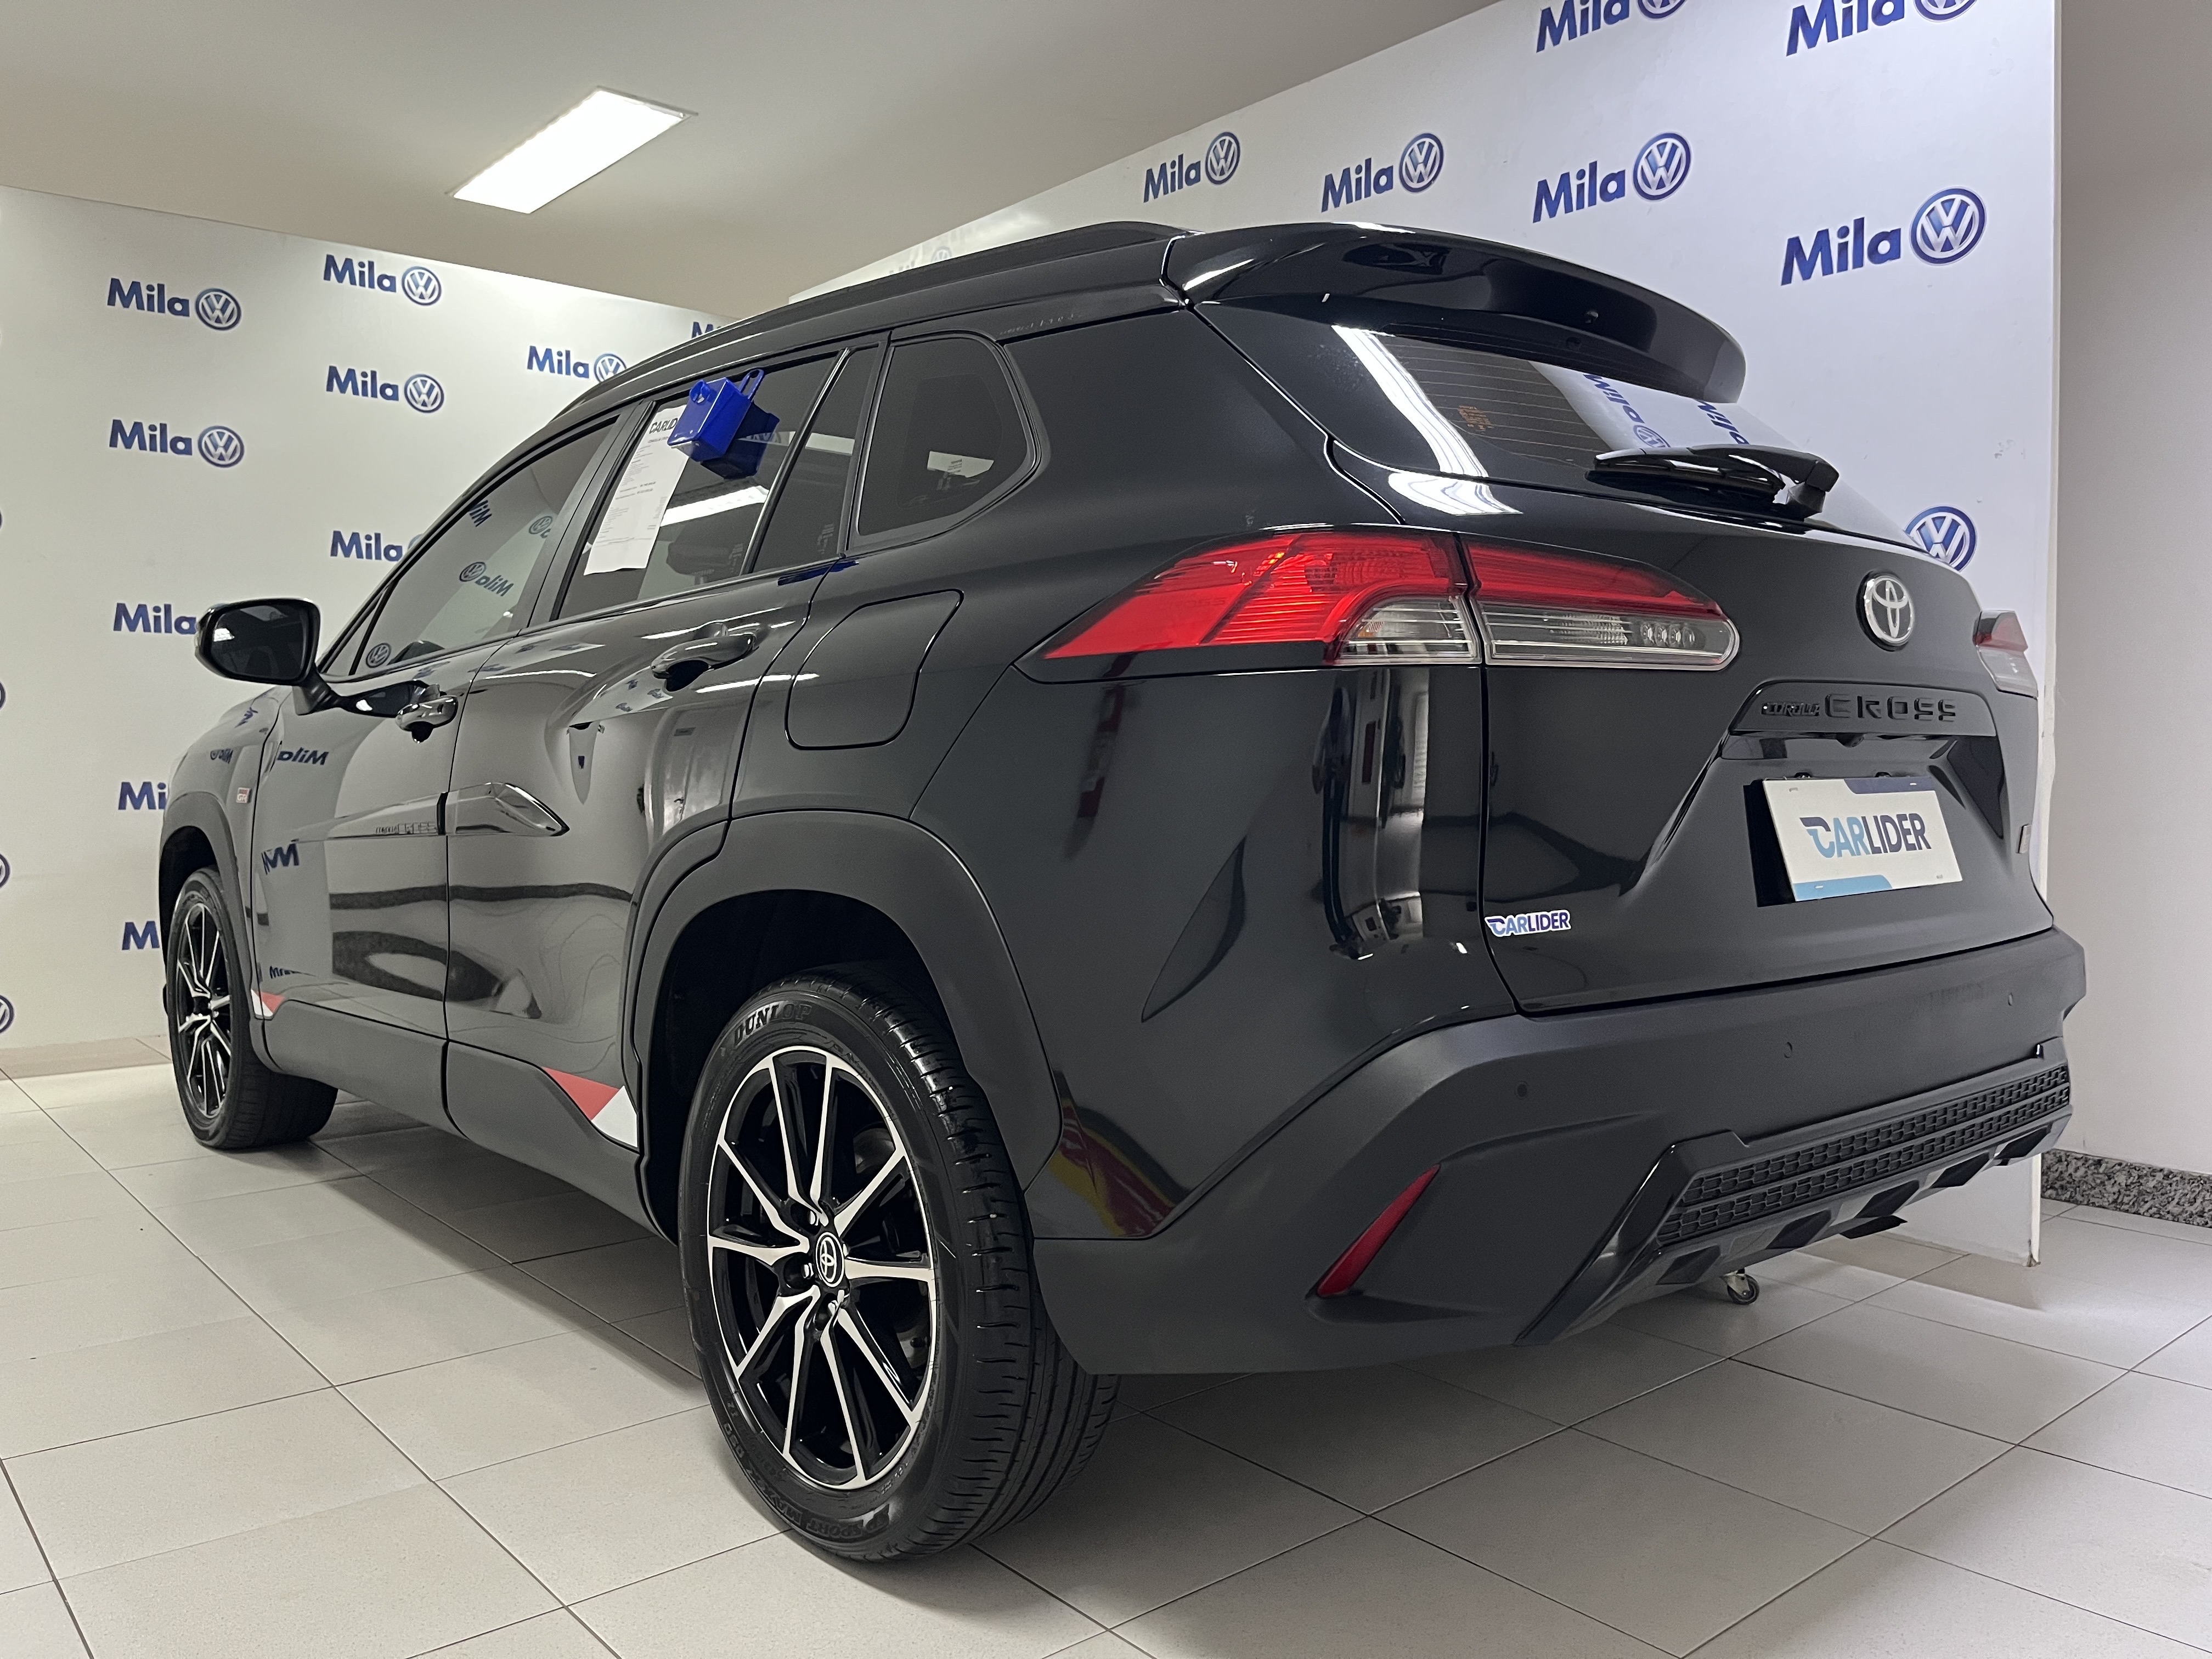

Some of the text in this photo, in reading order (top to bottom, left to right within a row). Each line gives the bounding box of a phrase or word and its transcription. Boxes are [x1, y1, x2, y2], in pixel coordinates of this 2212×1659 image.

[1537, 0, 1630, 53] Mila
[1786, 0, 1904, 56] Mila
[1143, 153, 1201, 203] Mila
[1321, 158, 1393, 212] Mila
[1533, 161, 1626, 223] Mila
[1781, 217, 1901, 286] Mila
[323, 253, 397, 292] Mila
[107, 278, 190, 317] Mila
[527, 346, 589, 379] Mila
[326, 365, 399, 402] Mila
[109, 419, 192, 455] Mila
[649, 418, 678, 434] CARLID
[330, 531, 402, 562] Mila
[113, 603, 196, 635] Mila
[1825, 693, 1956, 722] CROSS
[1799, 812, 1932, 857] CARLIDER
[1487, 911, 1569, 935] CARLIDER
[733, 1002, 812, 1047] DUNLOP
